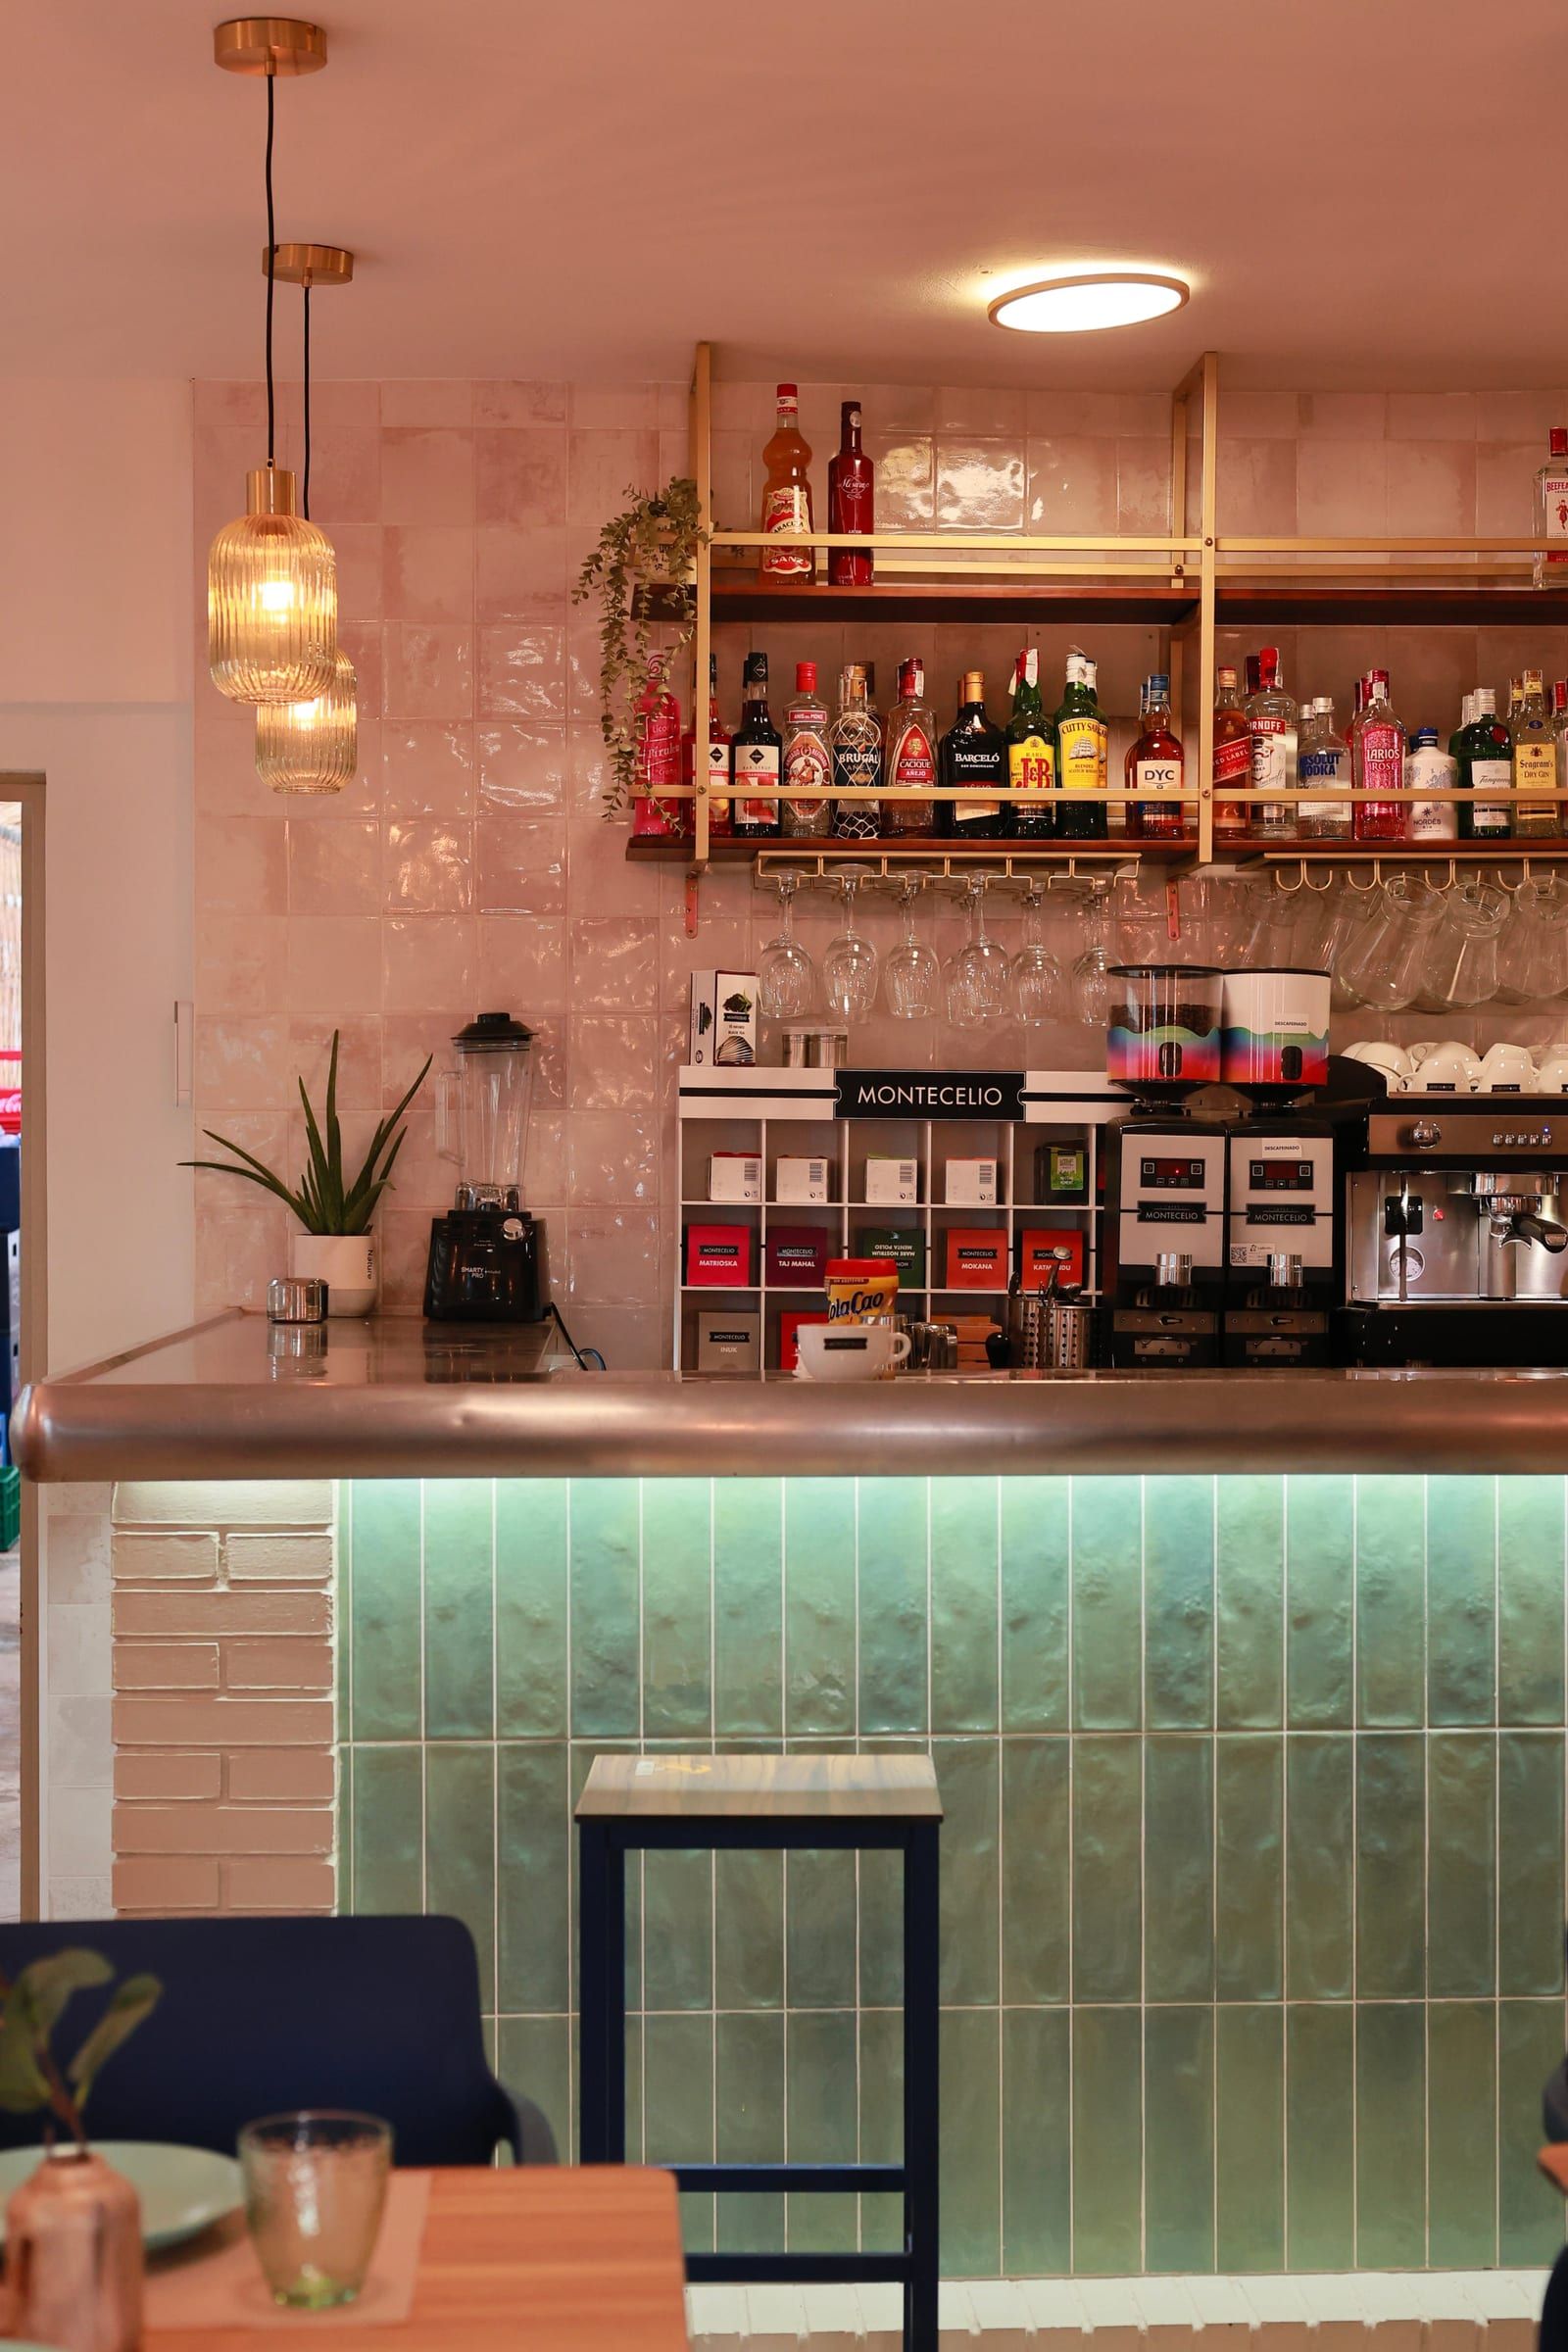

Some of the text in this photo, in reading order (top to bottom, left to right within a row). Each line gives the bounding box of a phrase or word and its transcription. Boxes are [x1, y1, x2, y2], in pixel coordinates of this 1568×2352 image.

[1546, 481, 1568, 492] BEEFEA
[770, 556, 805, 564] SANZ
[1061, 721, 1087, 735] CUTTY
[1250, 720, 1282, 731] IRNOFF
[839, 753, 879, 764] BRUGAL
[955, 752, 1000, 763] BARCELÓ
[1226, 749, 1250, 761] LABEL
[1367, 749, 1400, 762] LARIOS
[1519, 759, 1554, 770] Seagram's
[1015, 758, 1051, 789] J&B
[1144, 768, 1175, 781] DYC
[857, 1085, 1004, 1106] MONTECELIO
[1145, 1211, 1199, 1220] MONTECELIO
[1253, 1213, 1308, 1222] MONTECELIO
[828, 1291, 884, 1321] olaCao
